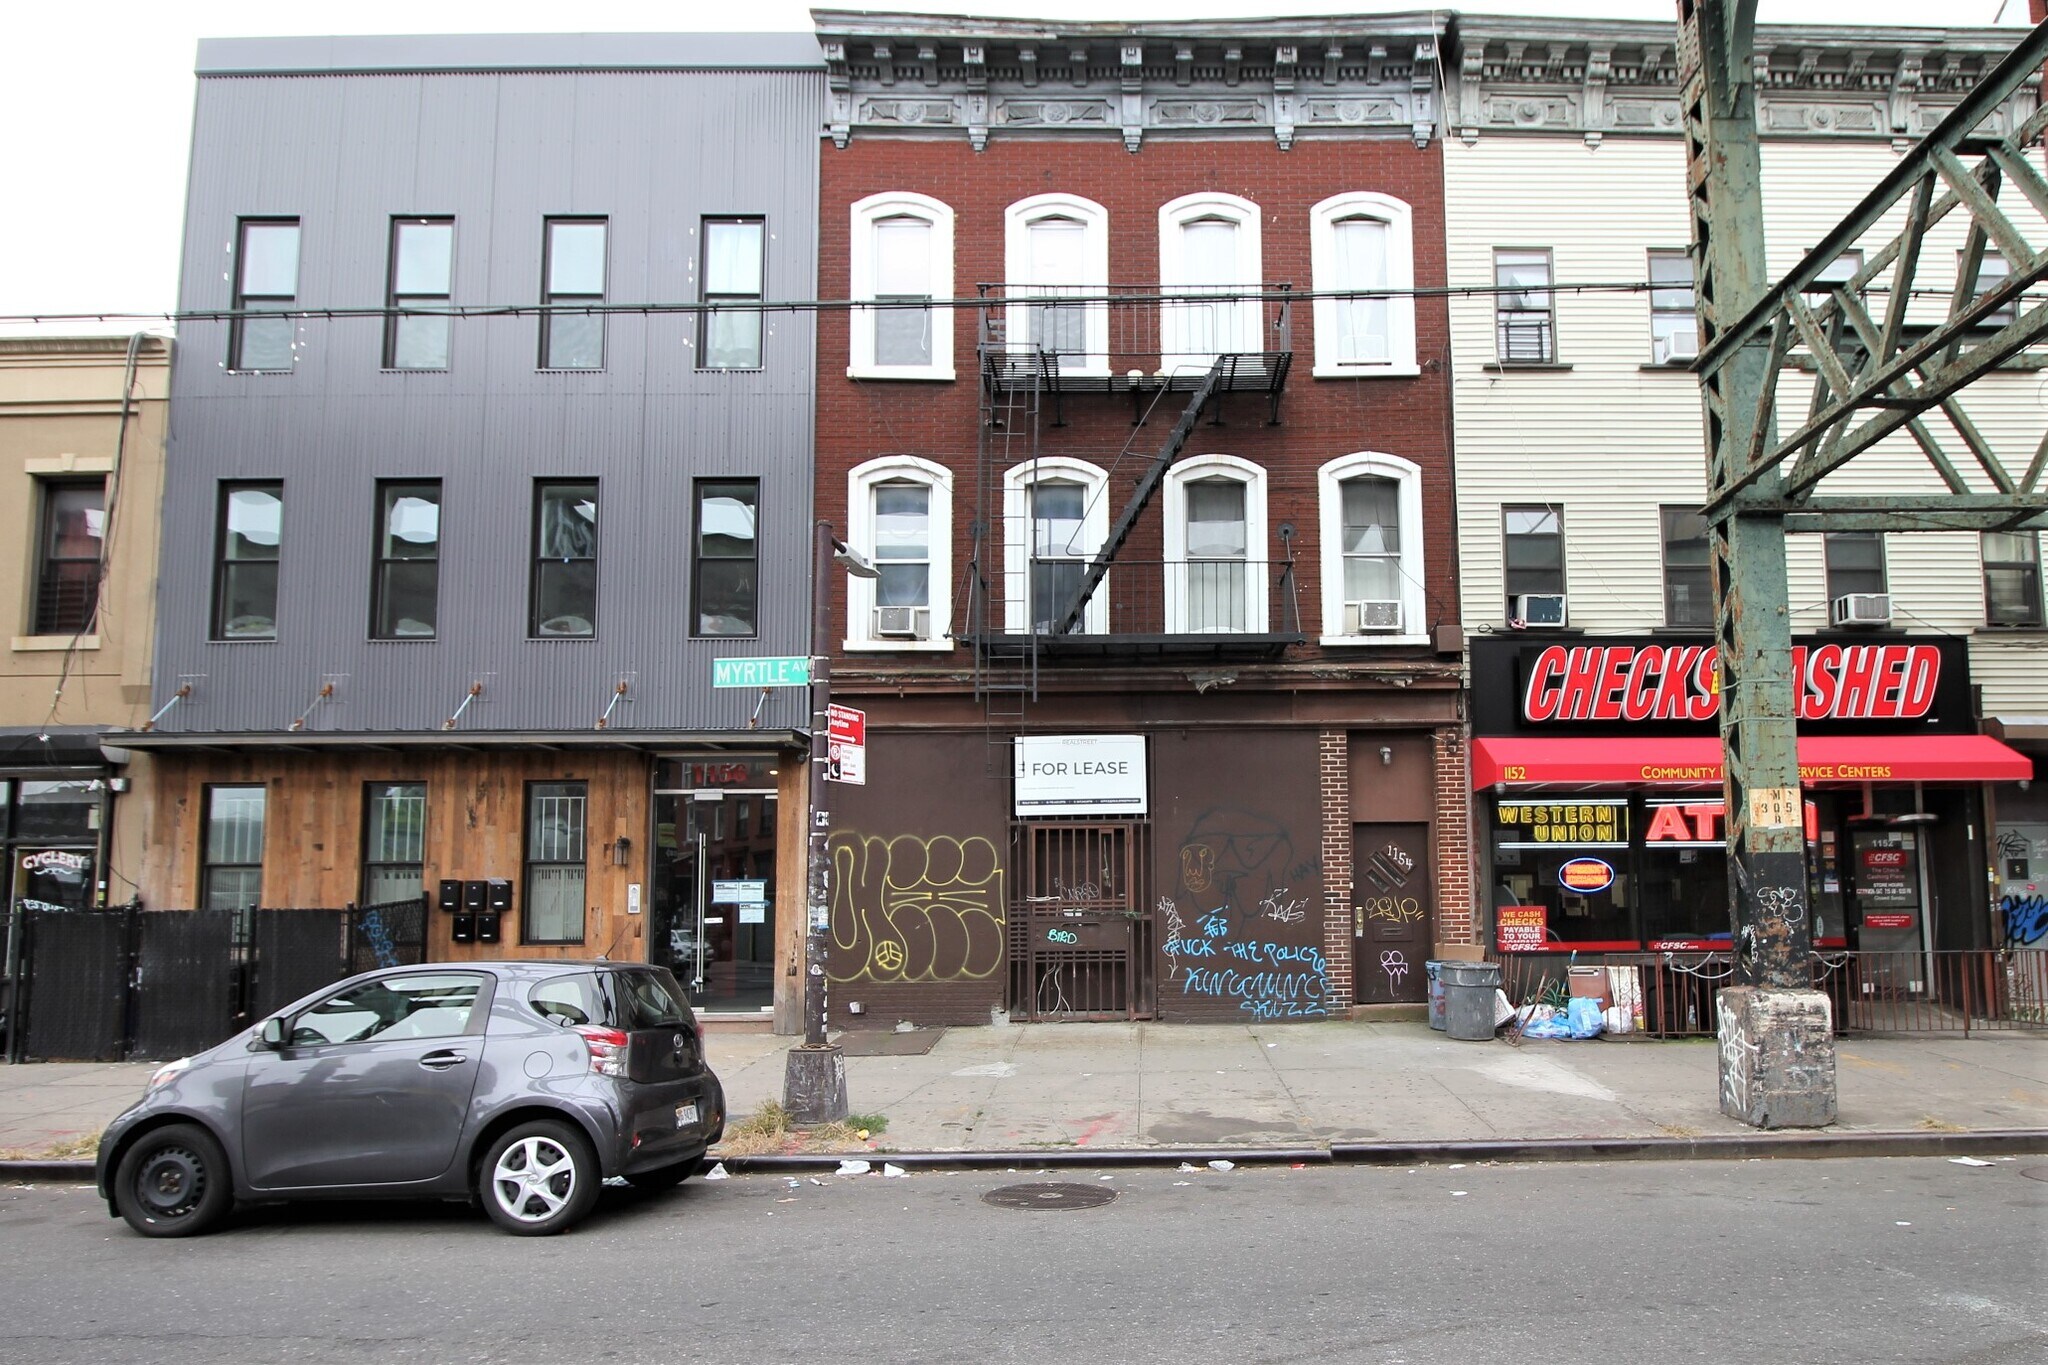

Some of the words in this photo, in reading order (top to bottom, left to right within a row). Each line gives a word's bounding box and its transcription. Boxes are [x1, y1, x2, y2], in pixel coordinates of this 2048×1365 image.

[715, 661, 789, 684] MYRTLE
[792, 662, 808, 671] AV
[1524, 645, 1720, 721] CHECKS
[1790, 645, 1941, 720] SHED
[1033, 763, 1067, 775] FOR
[1074, 761, 1128, 775] LEASE
[1504, 767, 1526, 780] 1152
[1641, 766, 1716, 780] COMMUNITY
[1838, 765, 1891, 778] CENTERS
[1499, 806, 1612, 824] WESTERN
[1645, 804, 1726, 841] AT
[1534, 824, 1612, 842] UNION
[1387, 845, 1413, 870] 1154
[1875, 853, 1901, 861] CFSC
[1500, 918, 1544, 926] CHECKS
[1047, 929, 1077, 944] BIRD
[1224, 941, 1262, 962] THE
